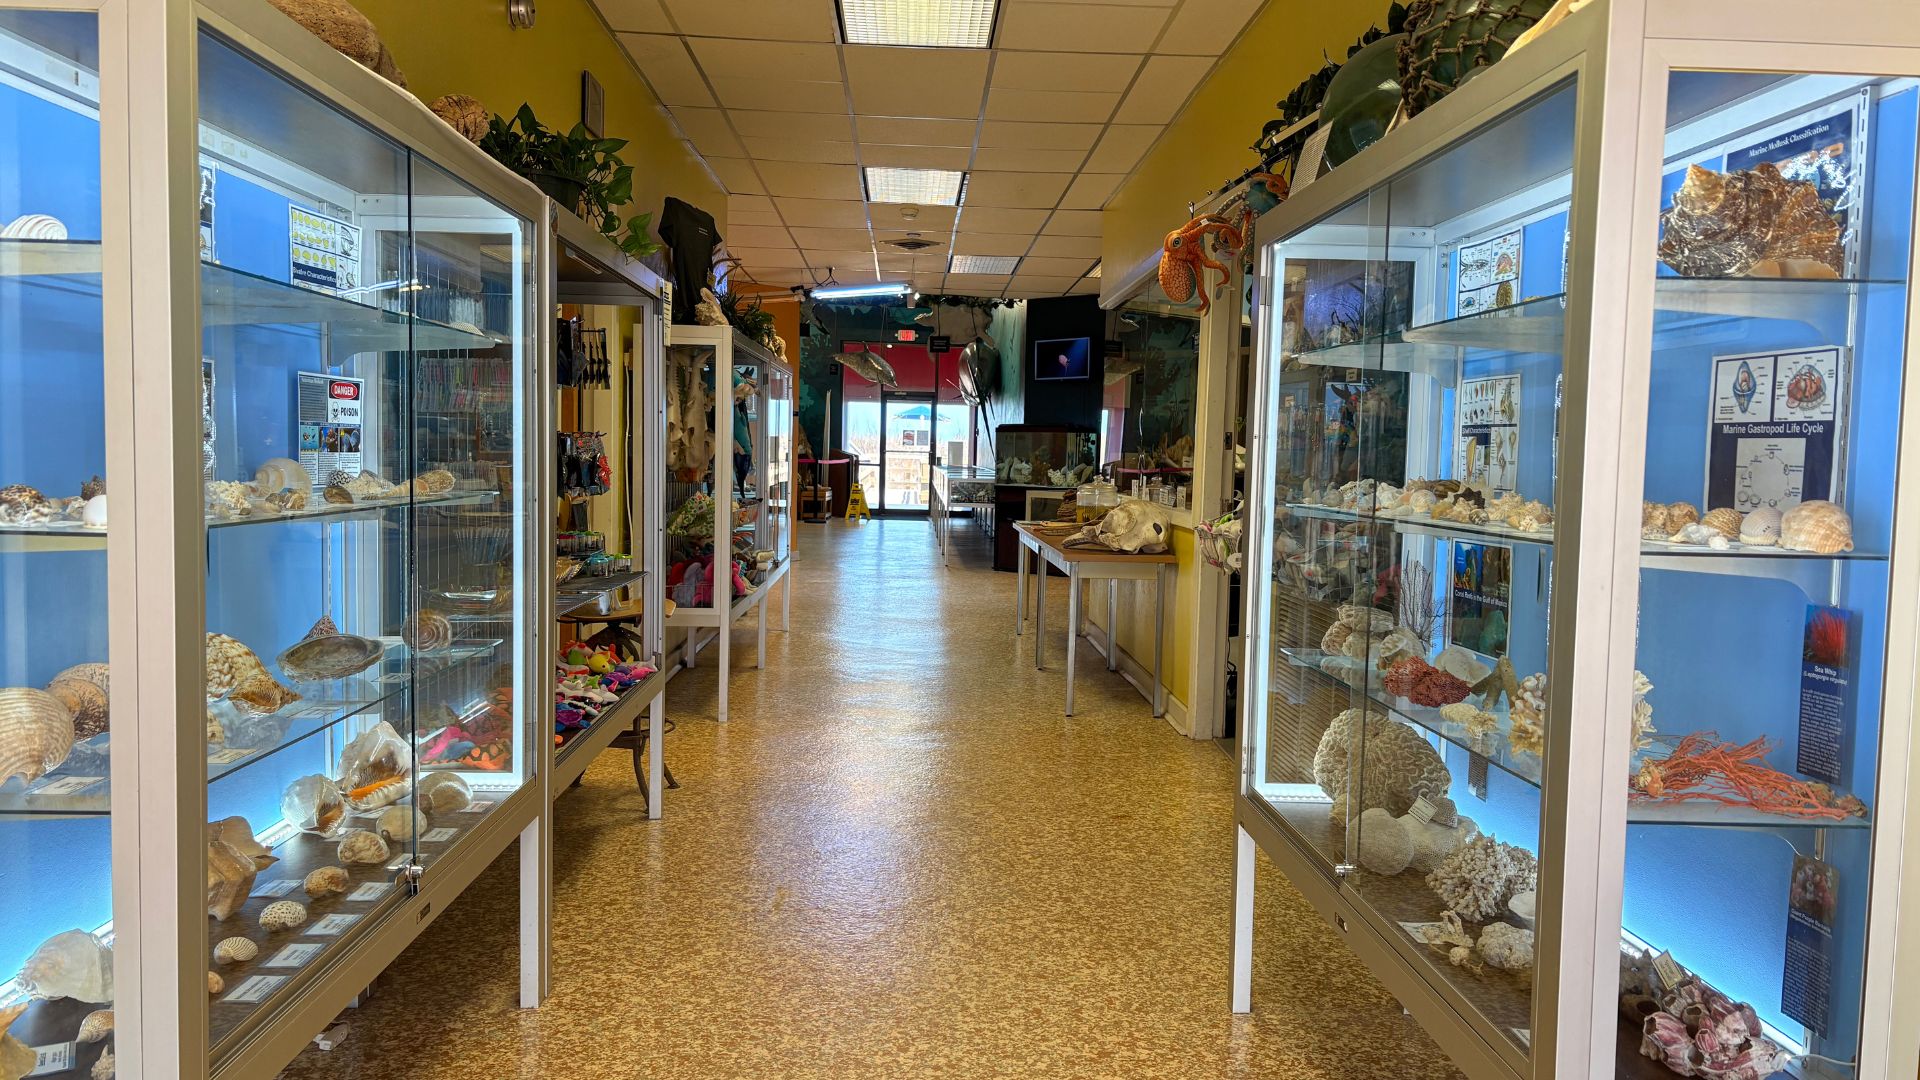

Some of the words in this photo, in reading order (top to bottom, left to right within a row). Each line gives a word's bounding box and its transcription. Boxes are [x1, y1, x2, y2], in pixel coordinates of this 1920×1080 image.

[1748, 146, 1768, 158] Marine
[1768, 137, 1790, 151] Mollusk
[1789, 124, 1829, 143] Classification
[334, 385, 354, 396] DANGER
[340, 407, 359, 417] POISON
[1722, 424, 1746, 434] Marine
[1747, 423, 1785, 436] Gastropod
[1786, 422, 1801, 433] Life
[1802, 422, 1824, 436] Cycle
[1814, 665, 1824, 674] Sea
[1824, 667, 1837, 677] Whip
